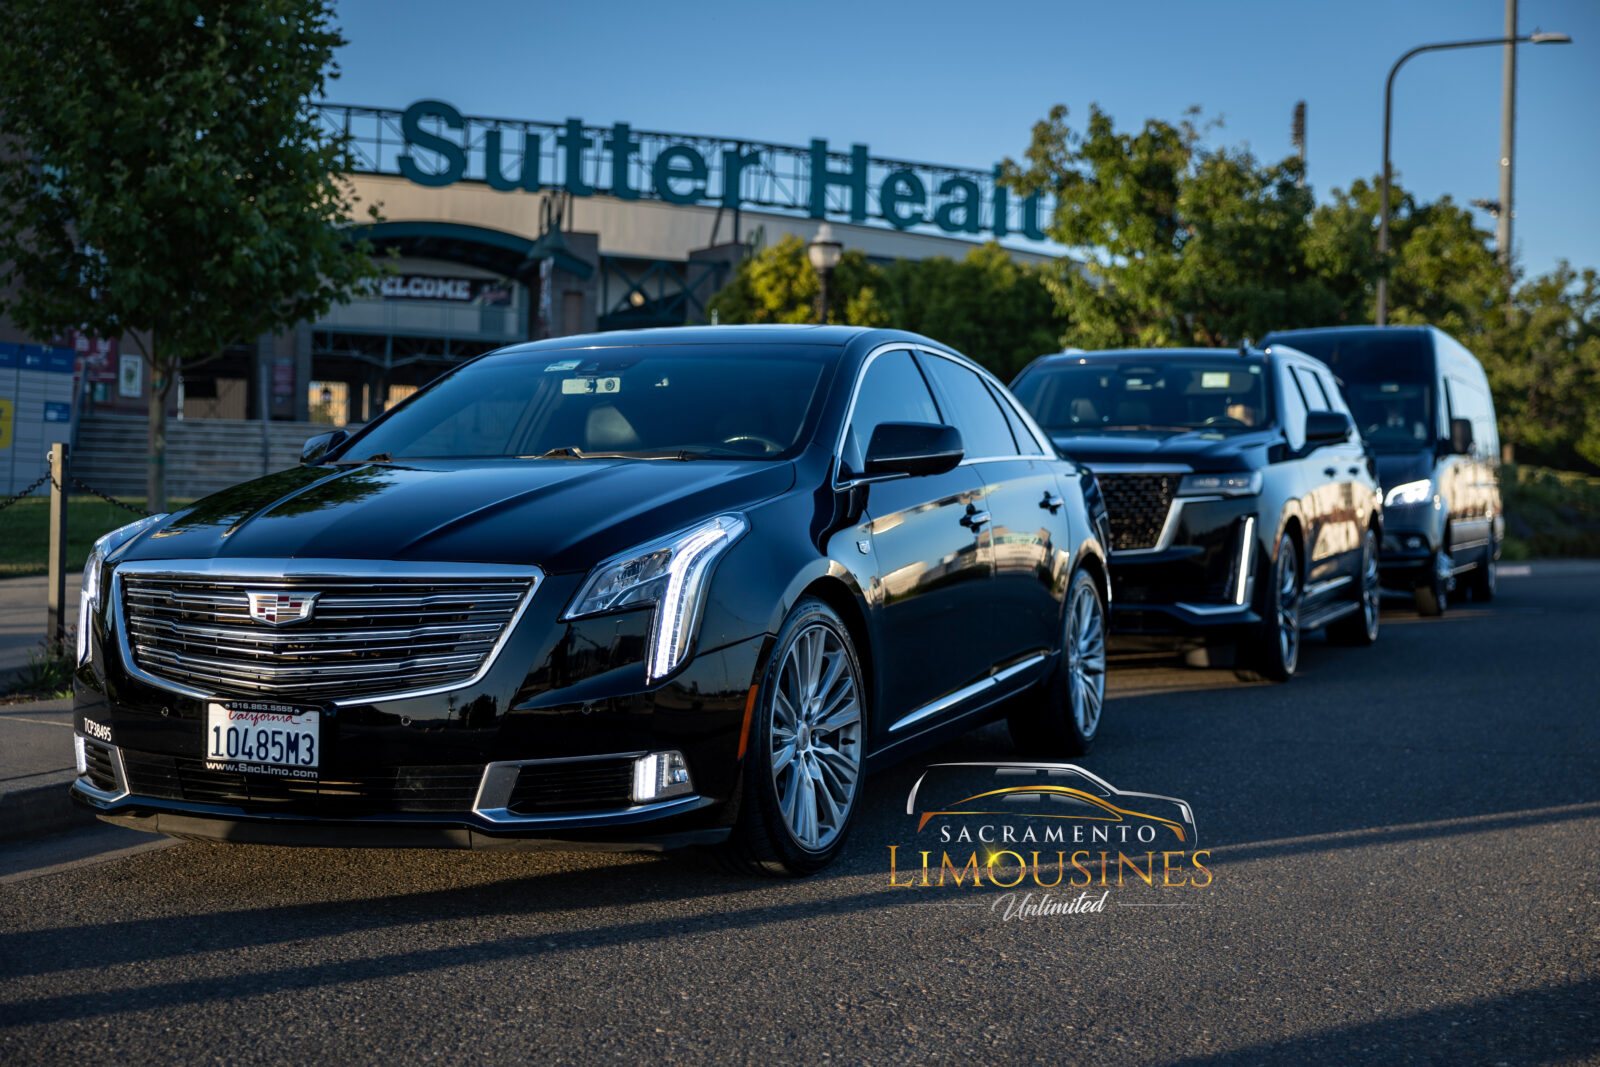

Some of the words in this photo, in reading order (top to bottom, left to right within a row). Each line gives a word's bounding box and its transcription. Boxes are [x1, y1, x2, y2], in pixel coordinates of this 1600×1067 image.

[396, 99, 761, 209] Sutter
[808, 138, 1062, 241] Healt
[83, 717, 112, 742] TCP38495
[228, 710, 301, 727] California
[210, 724, 315, 766] 10485M3
[205, 762, 318, 778] www.SacLimo.com
